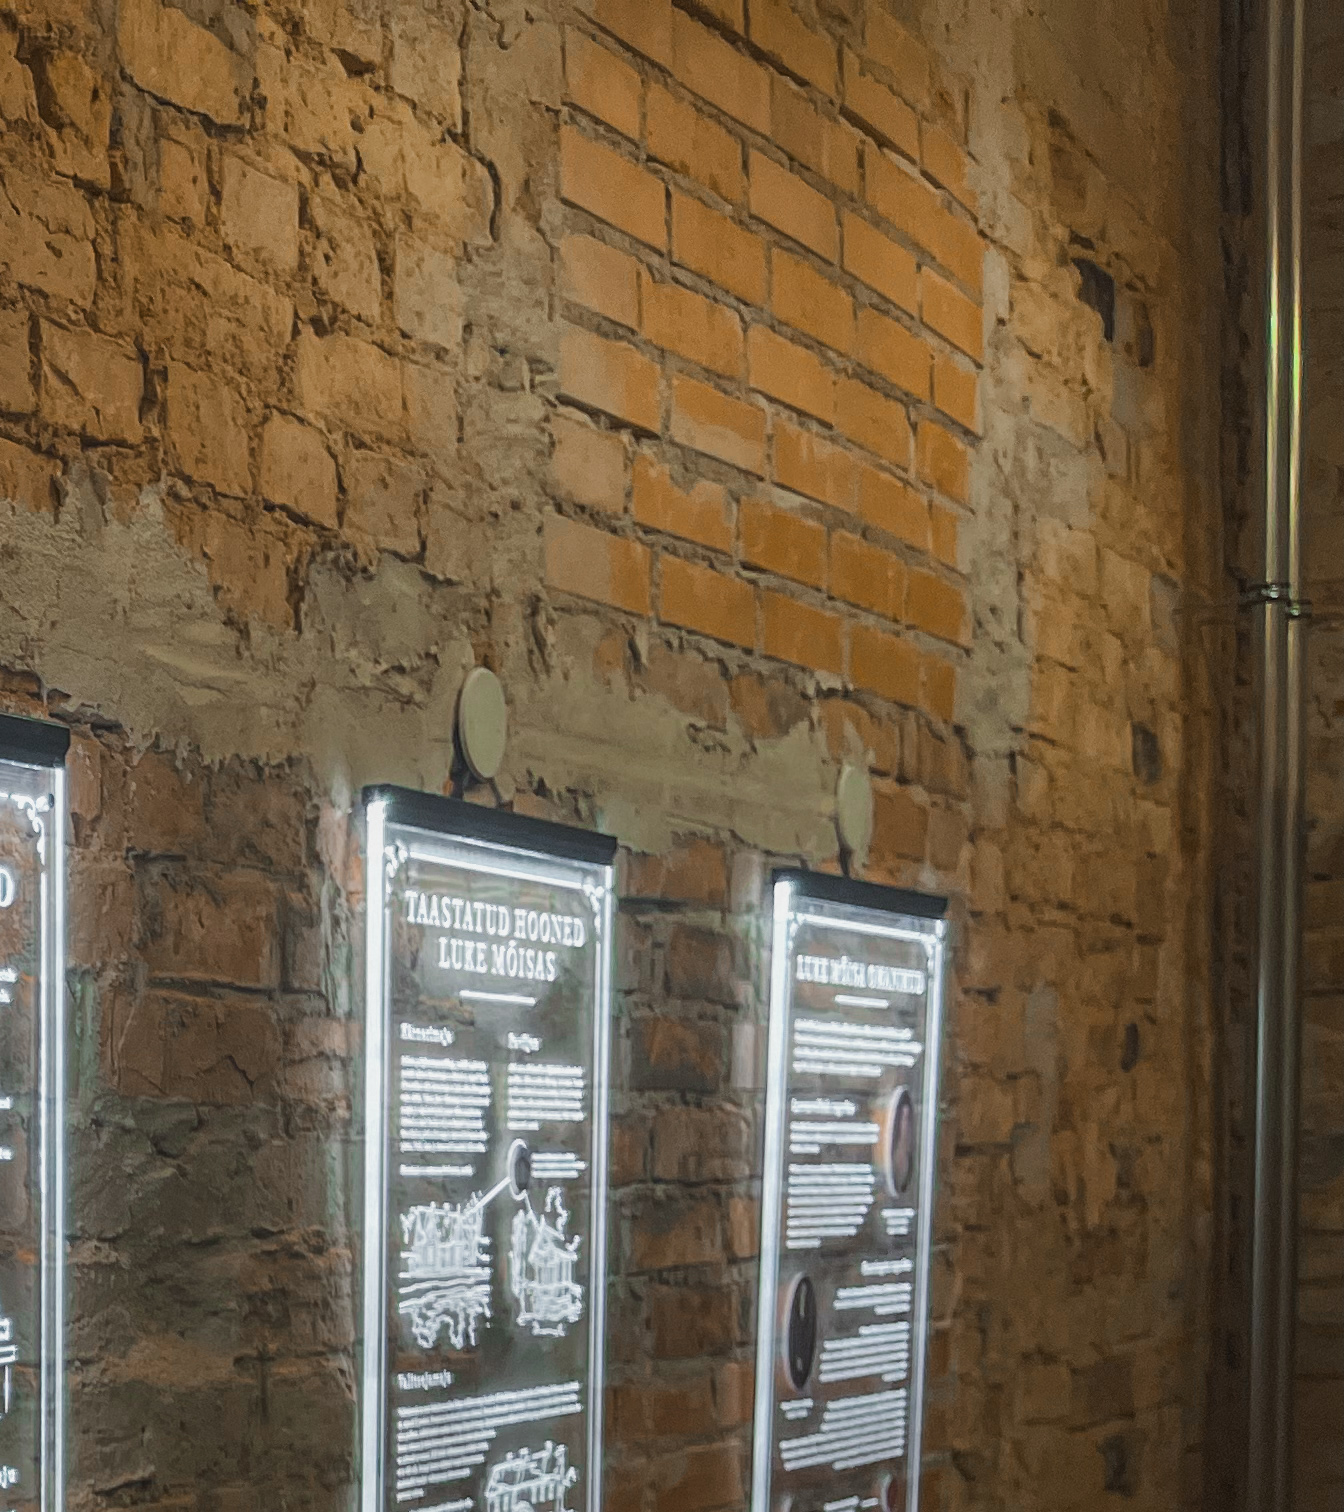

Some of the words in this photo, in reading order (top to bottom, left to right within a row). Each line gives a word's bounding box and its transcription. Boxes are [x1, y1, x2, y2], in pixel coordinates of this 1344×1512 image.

[405, 891, 509, 936] TAASTATUD
[514, 908, 586, 947] HOONED
[438, 937, 488, 974] LUKE
